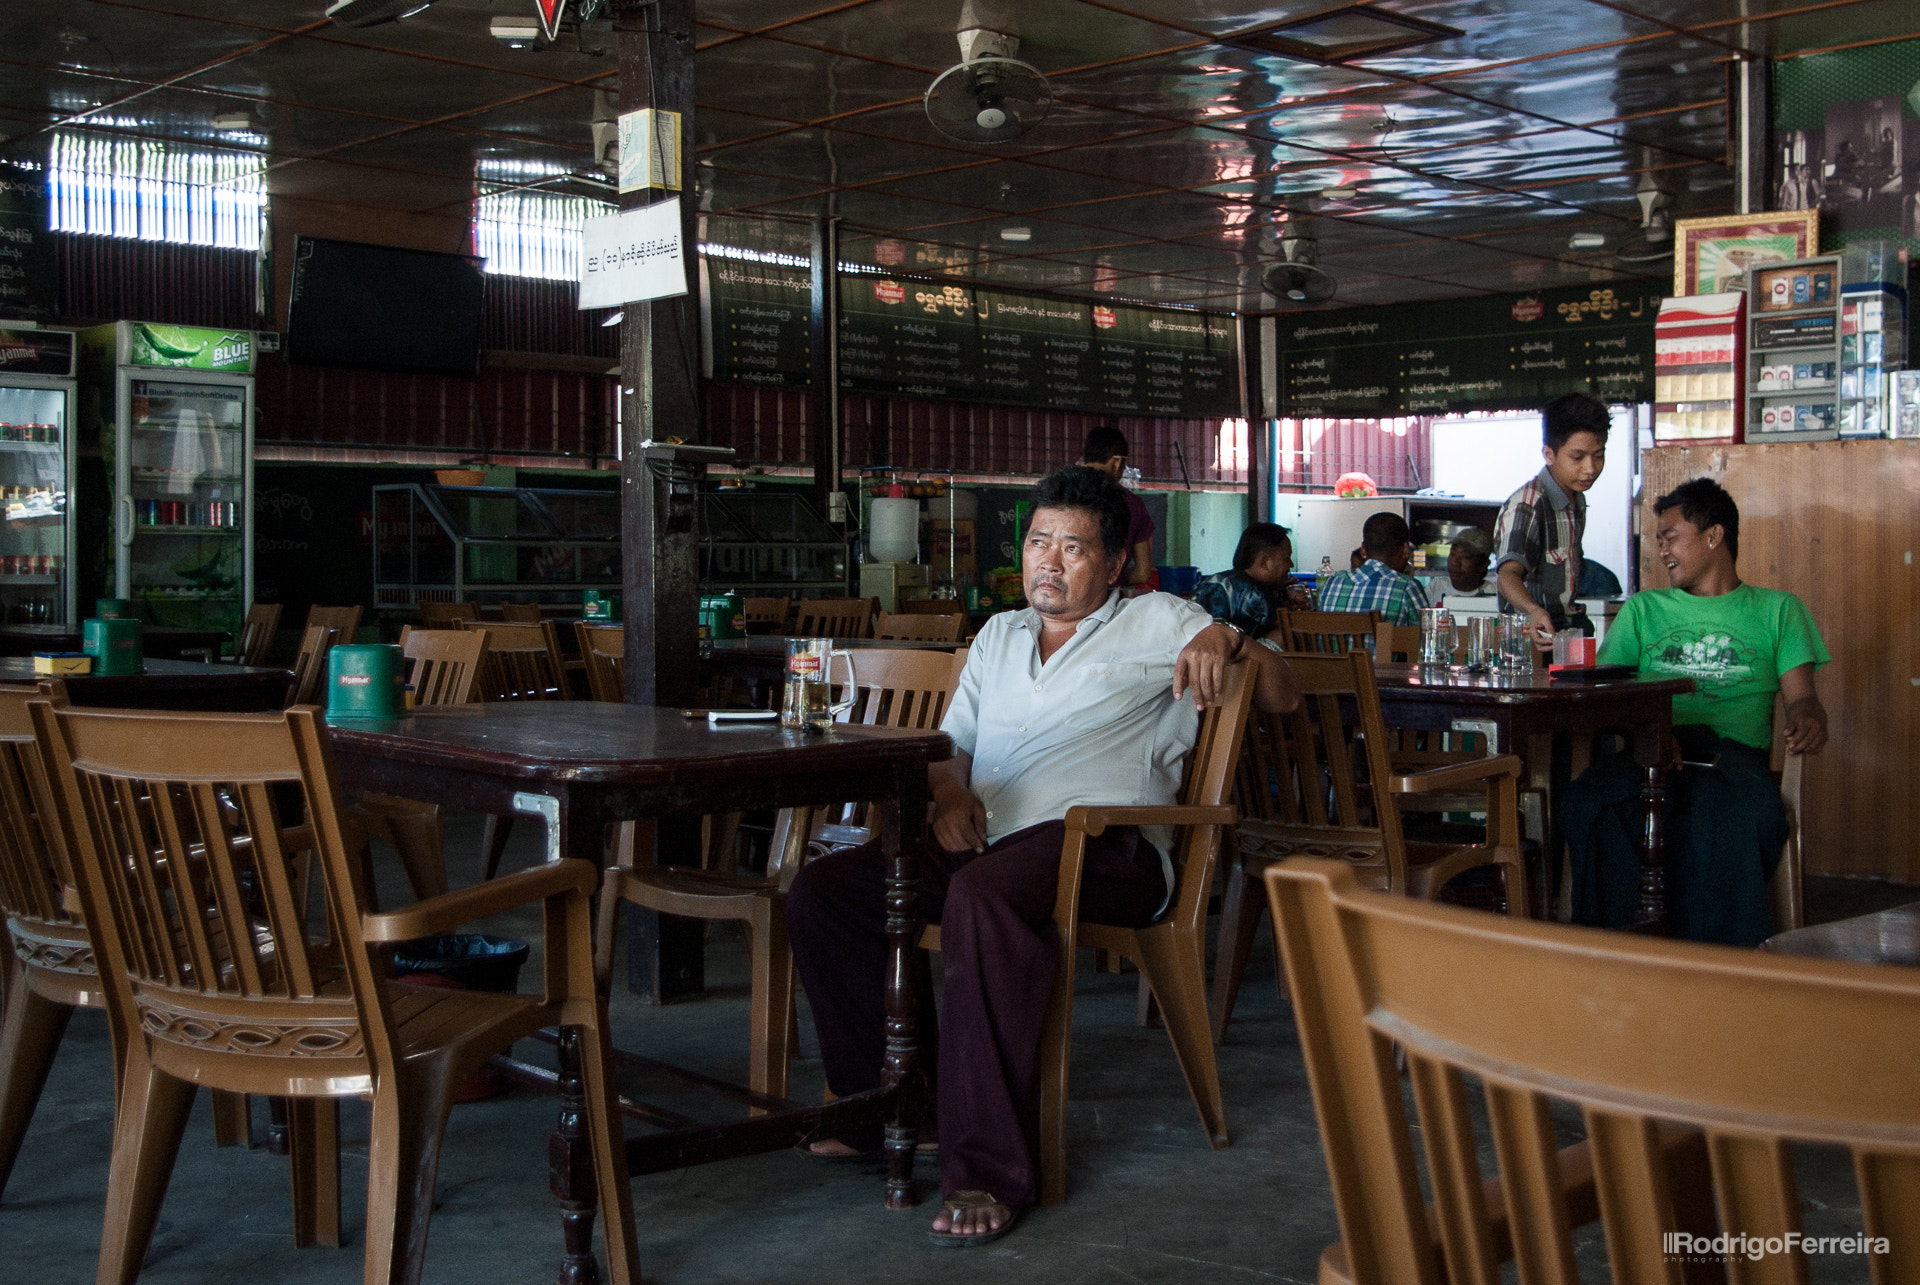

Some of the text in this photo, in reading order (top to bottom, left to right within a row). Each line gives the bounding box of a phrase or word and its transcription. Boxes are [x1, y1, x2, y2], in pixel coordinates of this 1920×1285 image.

[0, 347, 36, 364] yanmar
[213, 341, 250, 361] BLUE
[212, 355, 250, 368] MOUNTAIN
